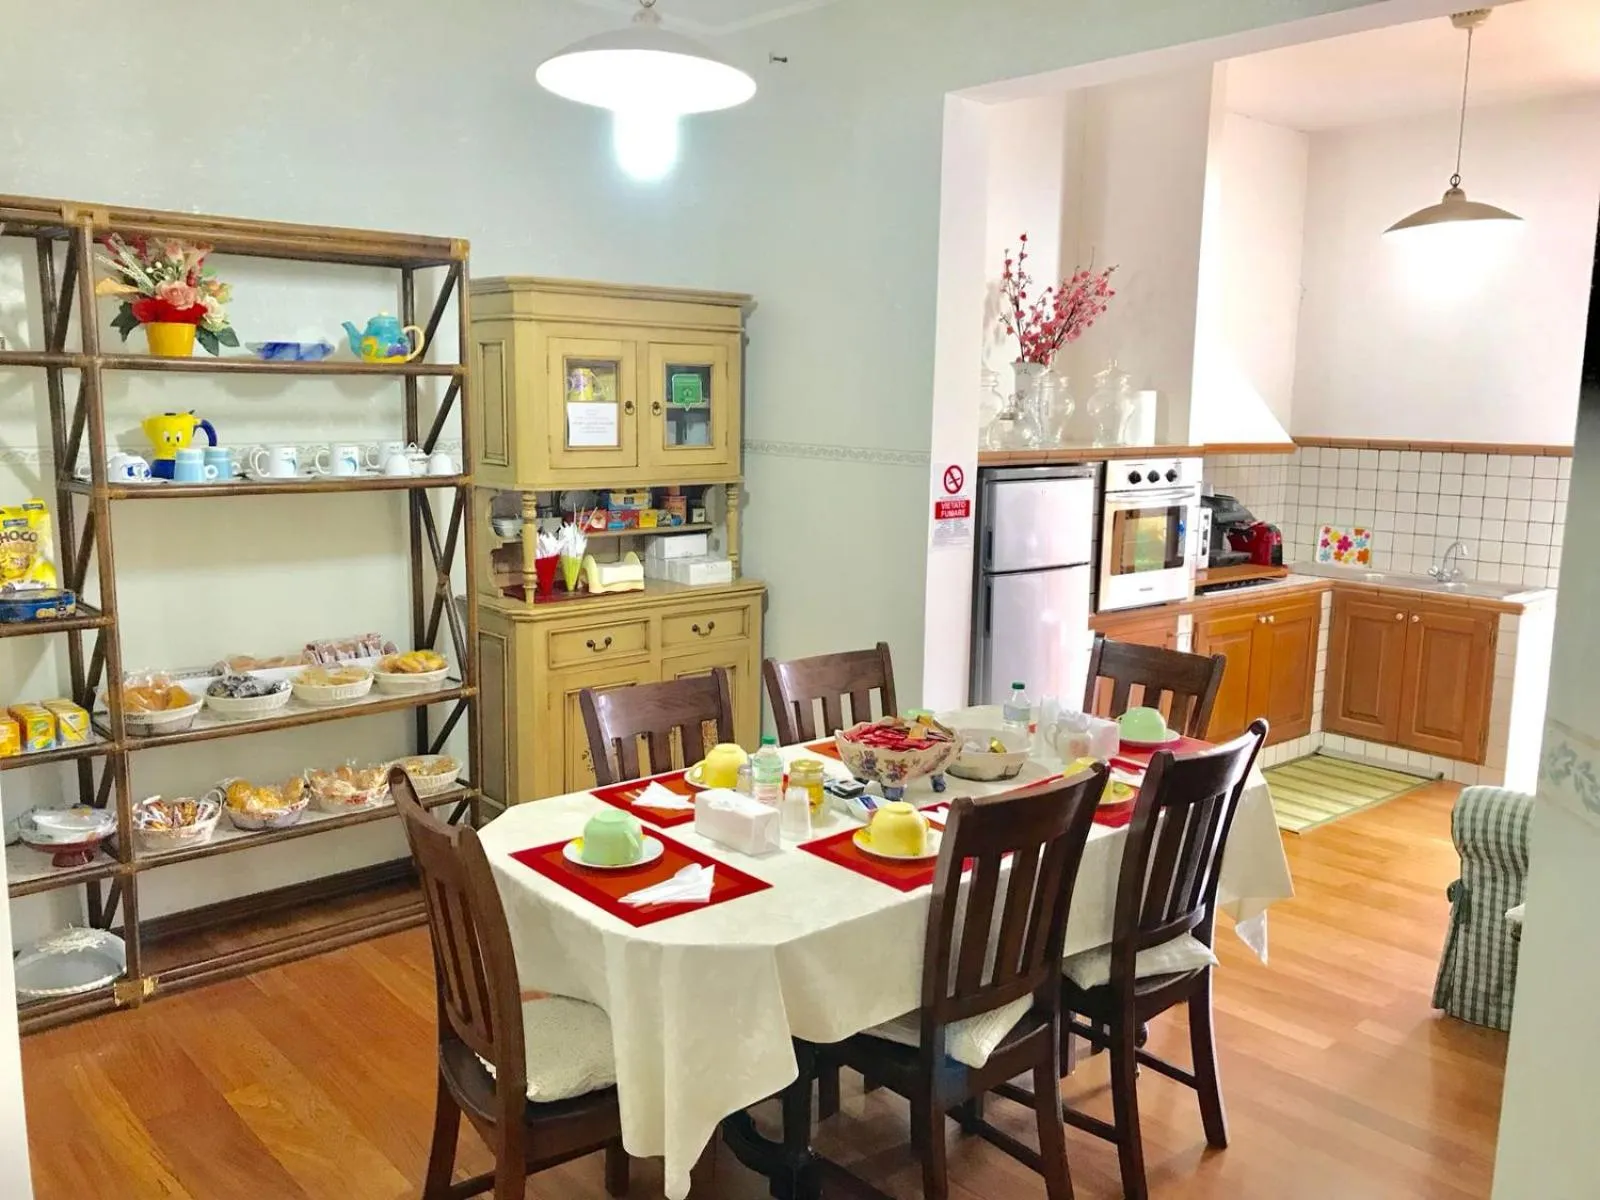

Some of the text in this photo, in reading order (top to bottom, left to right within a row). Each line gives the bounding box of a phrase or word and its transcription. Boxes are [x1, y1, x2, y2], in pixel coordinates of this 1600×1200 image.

[941, 502, 967, 510] VIETATO
[940, 509, 966, 517] FUMARE
[0, 530, 38, 543] HOCO
